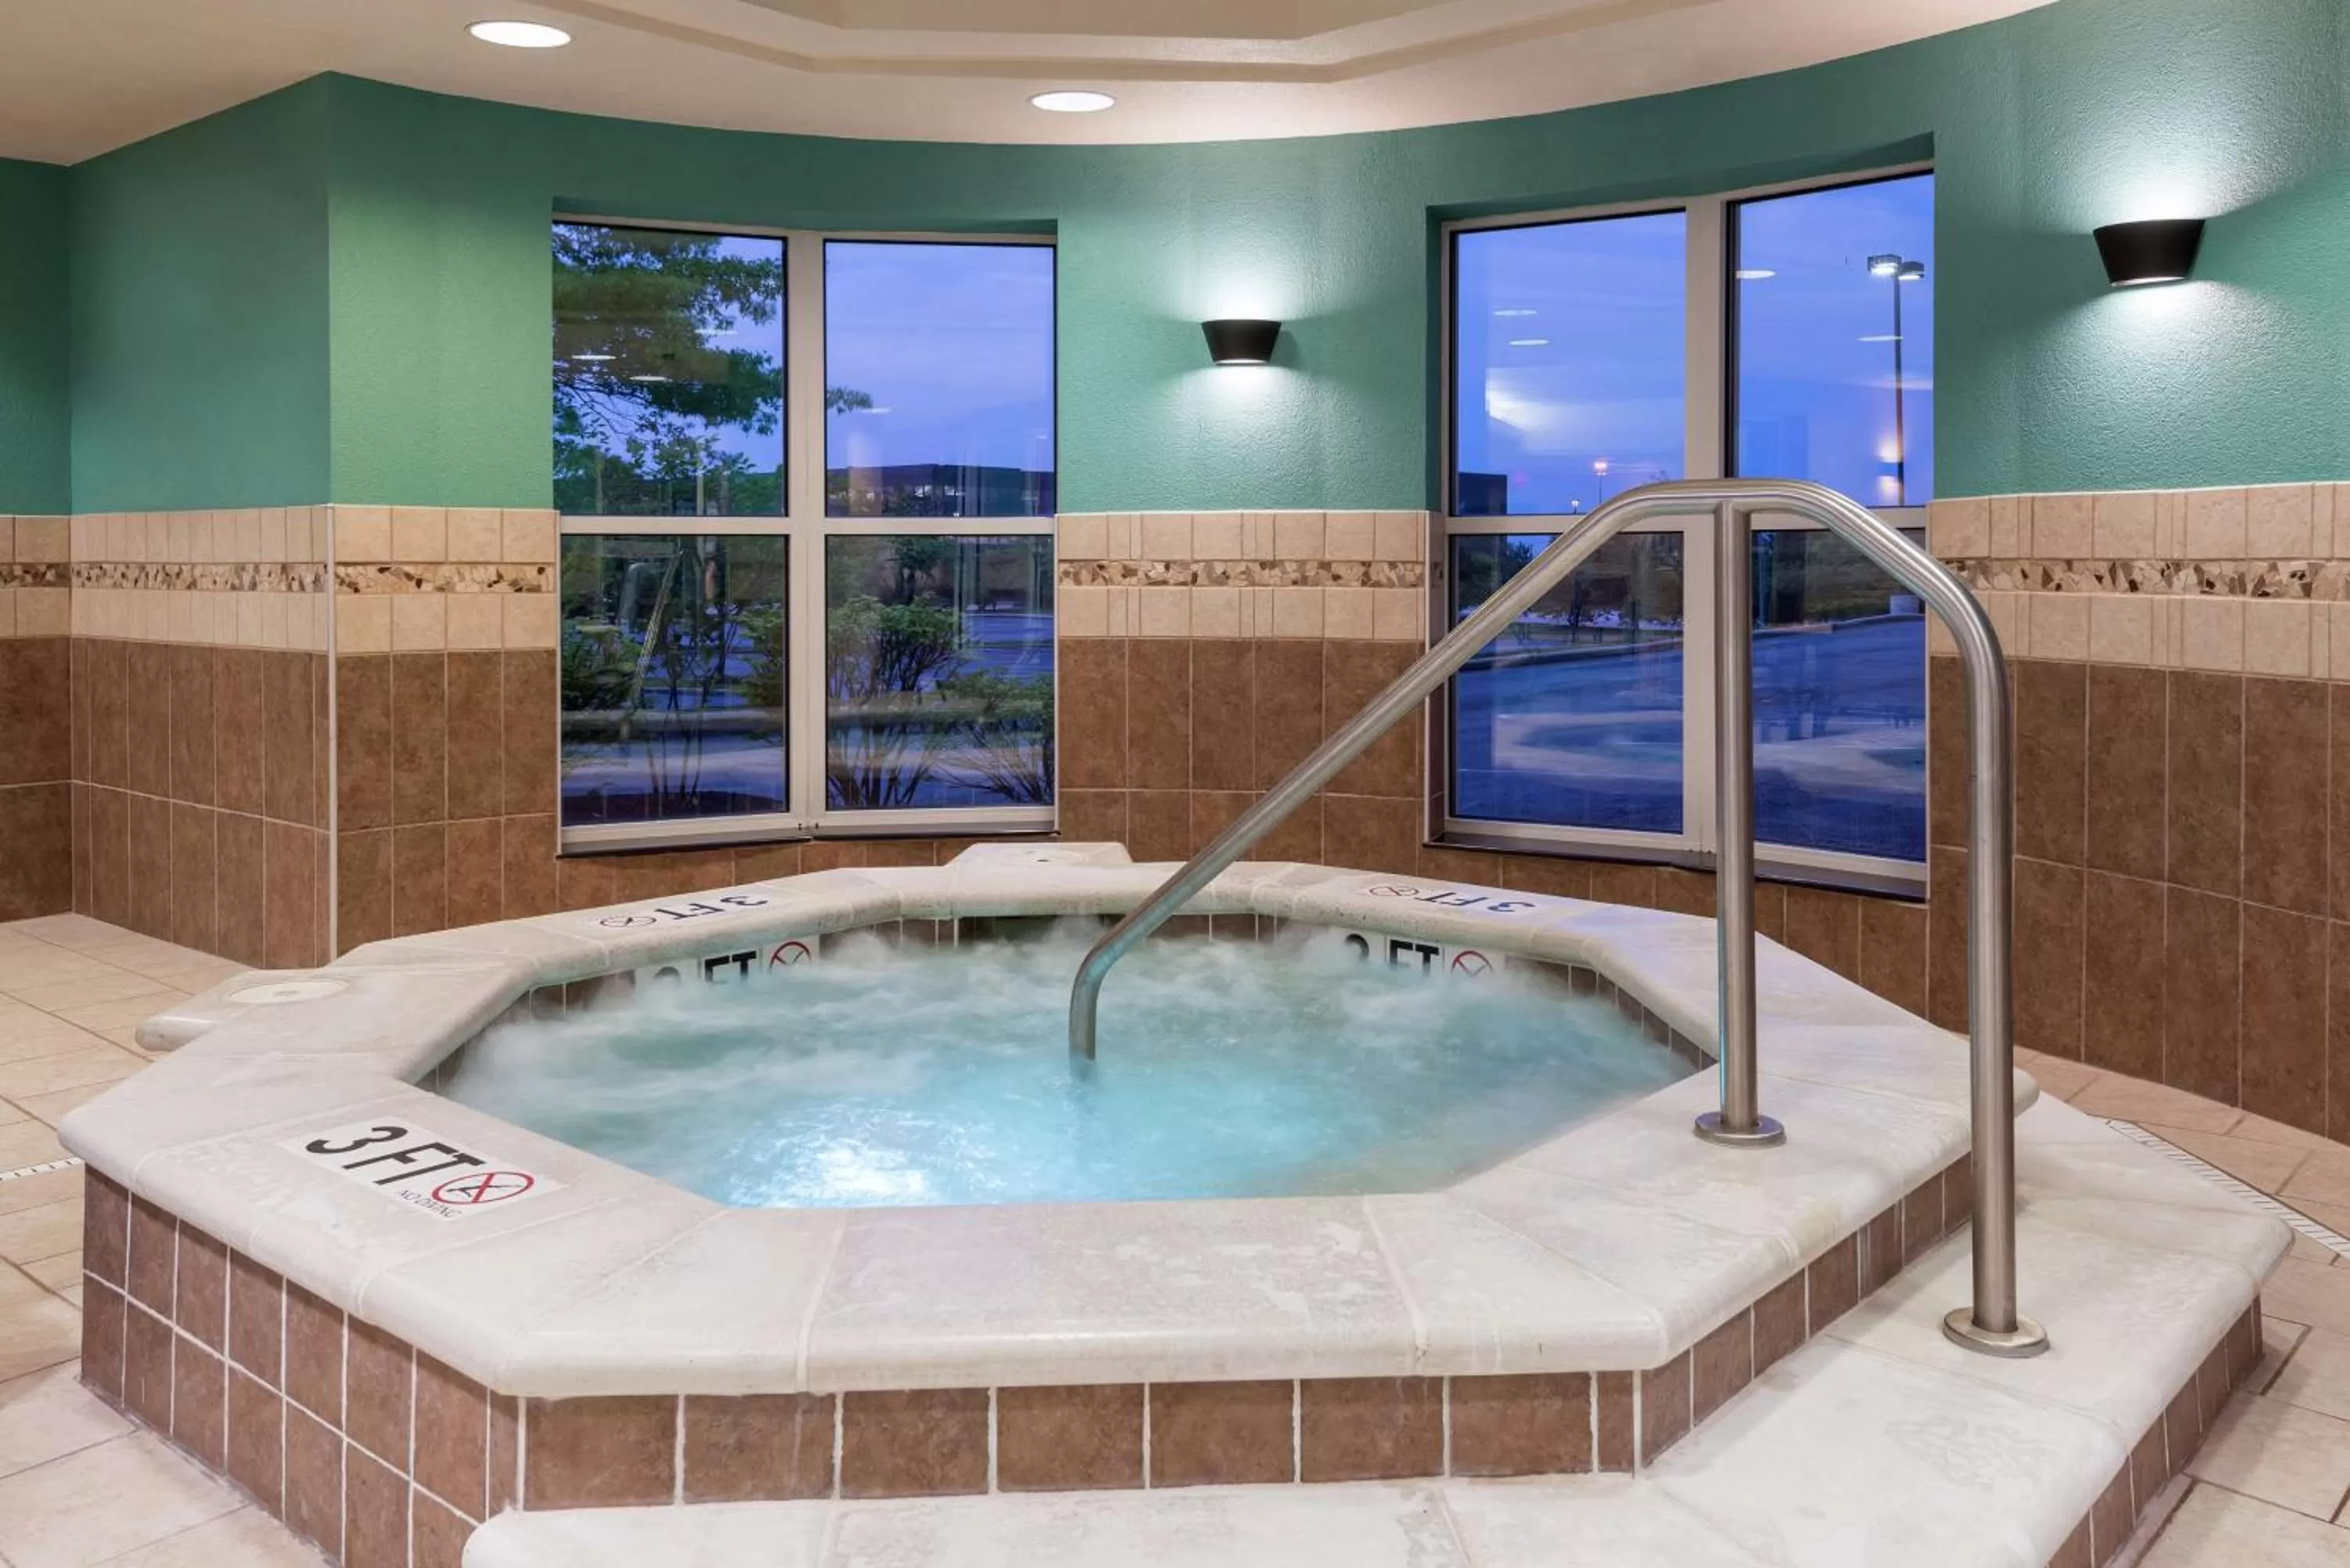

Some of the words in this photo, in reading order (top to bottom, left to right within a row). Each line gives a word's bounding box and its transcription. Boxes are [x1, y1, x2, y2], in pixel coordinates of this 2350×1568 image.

[1415, 892, 1490, 906] FT
[654, 903, 725, 919] FT
[306, 1125, 408, 1153] 3
[342, 1142, 486, 1185] FT
